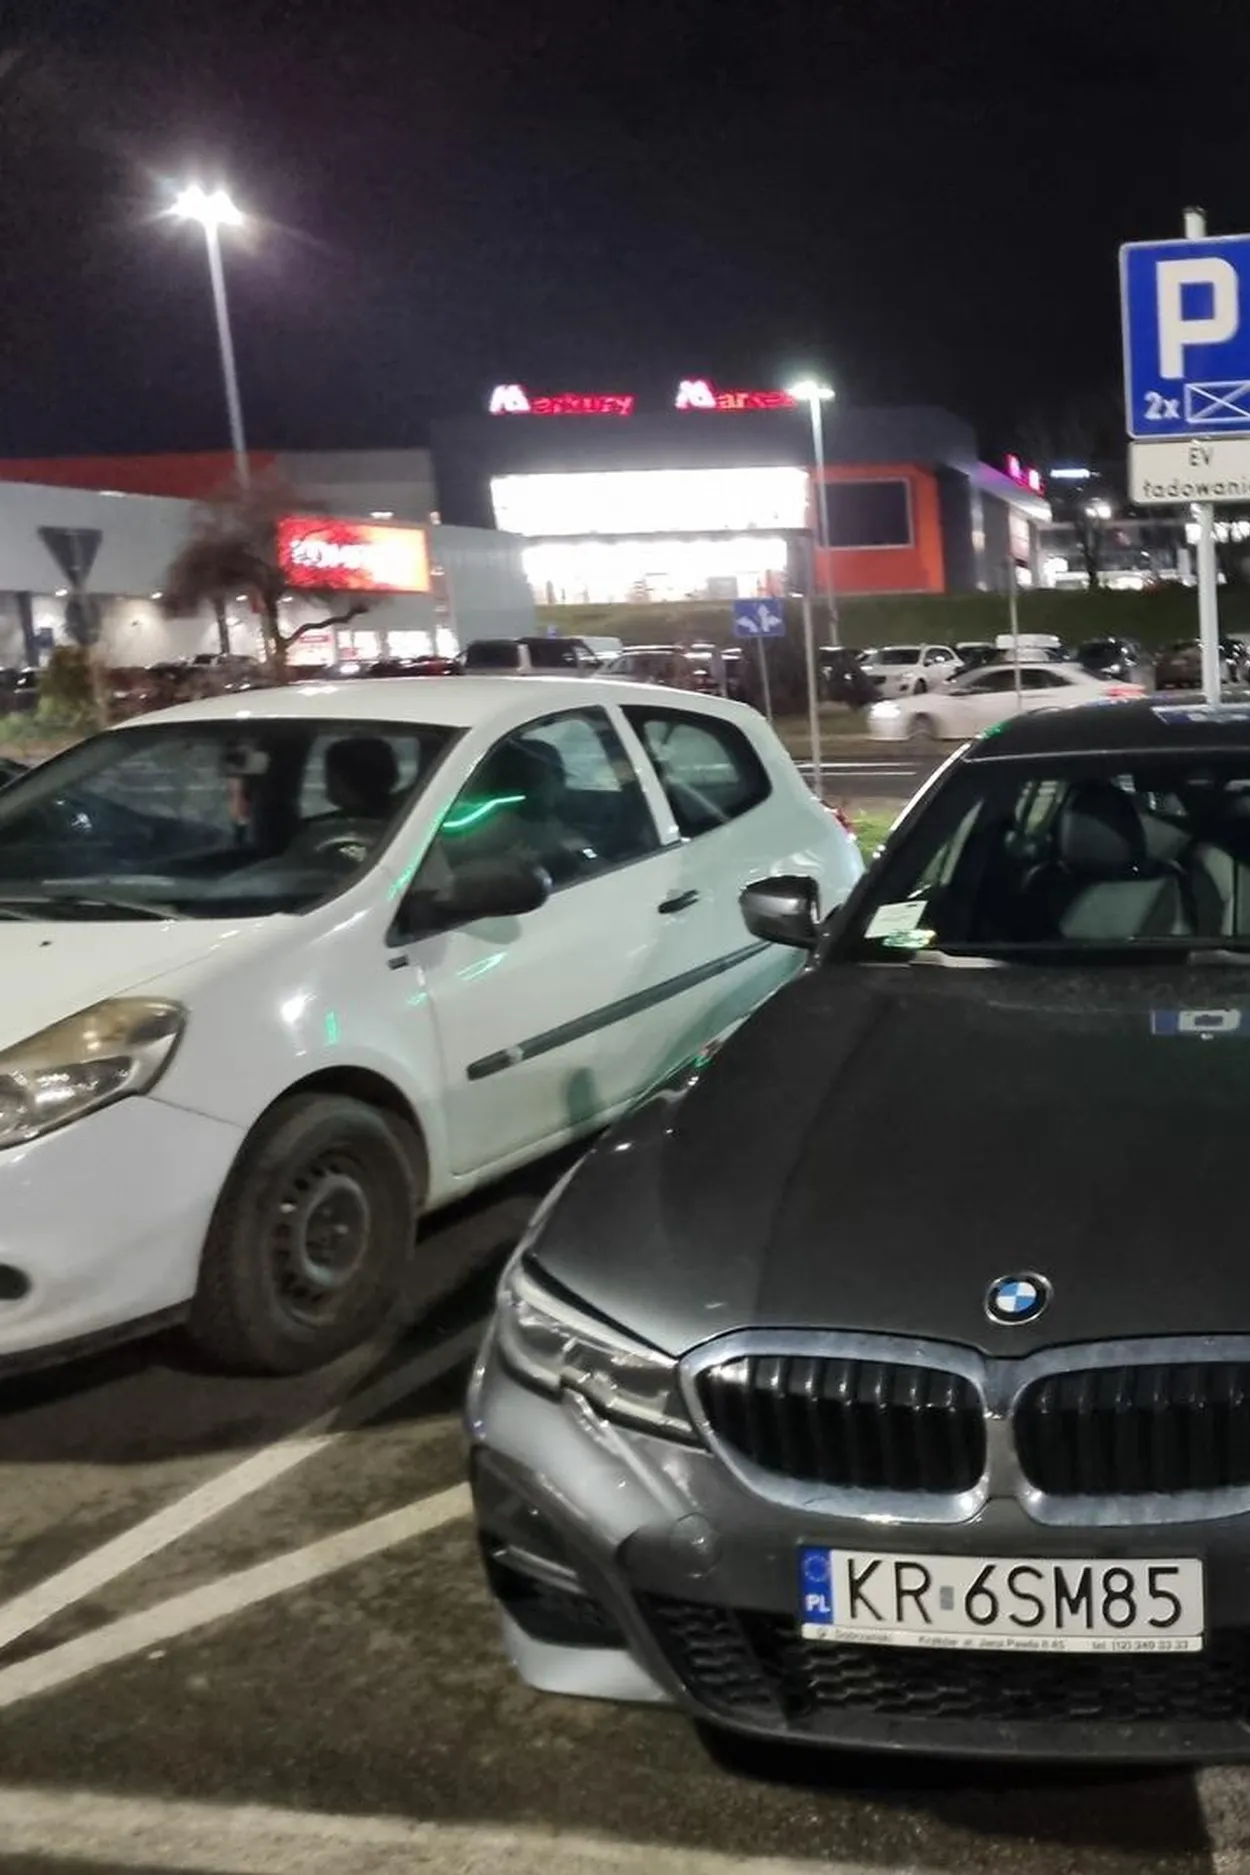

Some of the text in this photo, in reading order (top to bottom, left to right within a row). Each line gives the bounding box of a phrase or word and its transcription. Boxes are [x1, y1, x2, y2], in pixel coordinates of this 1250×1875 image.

[1156, 257, 1239, 380] P
[1143, 391, 1181, 421] 2x
[1189, 446, 1215, 467] EV
[806, 1594, 831, 1613] PL
[847, 1558, 1182, 1629] KR 6SM85
